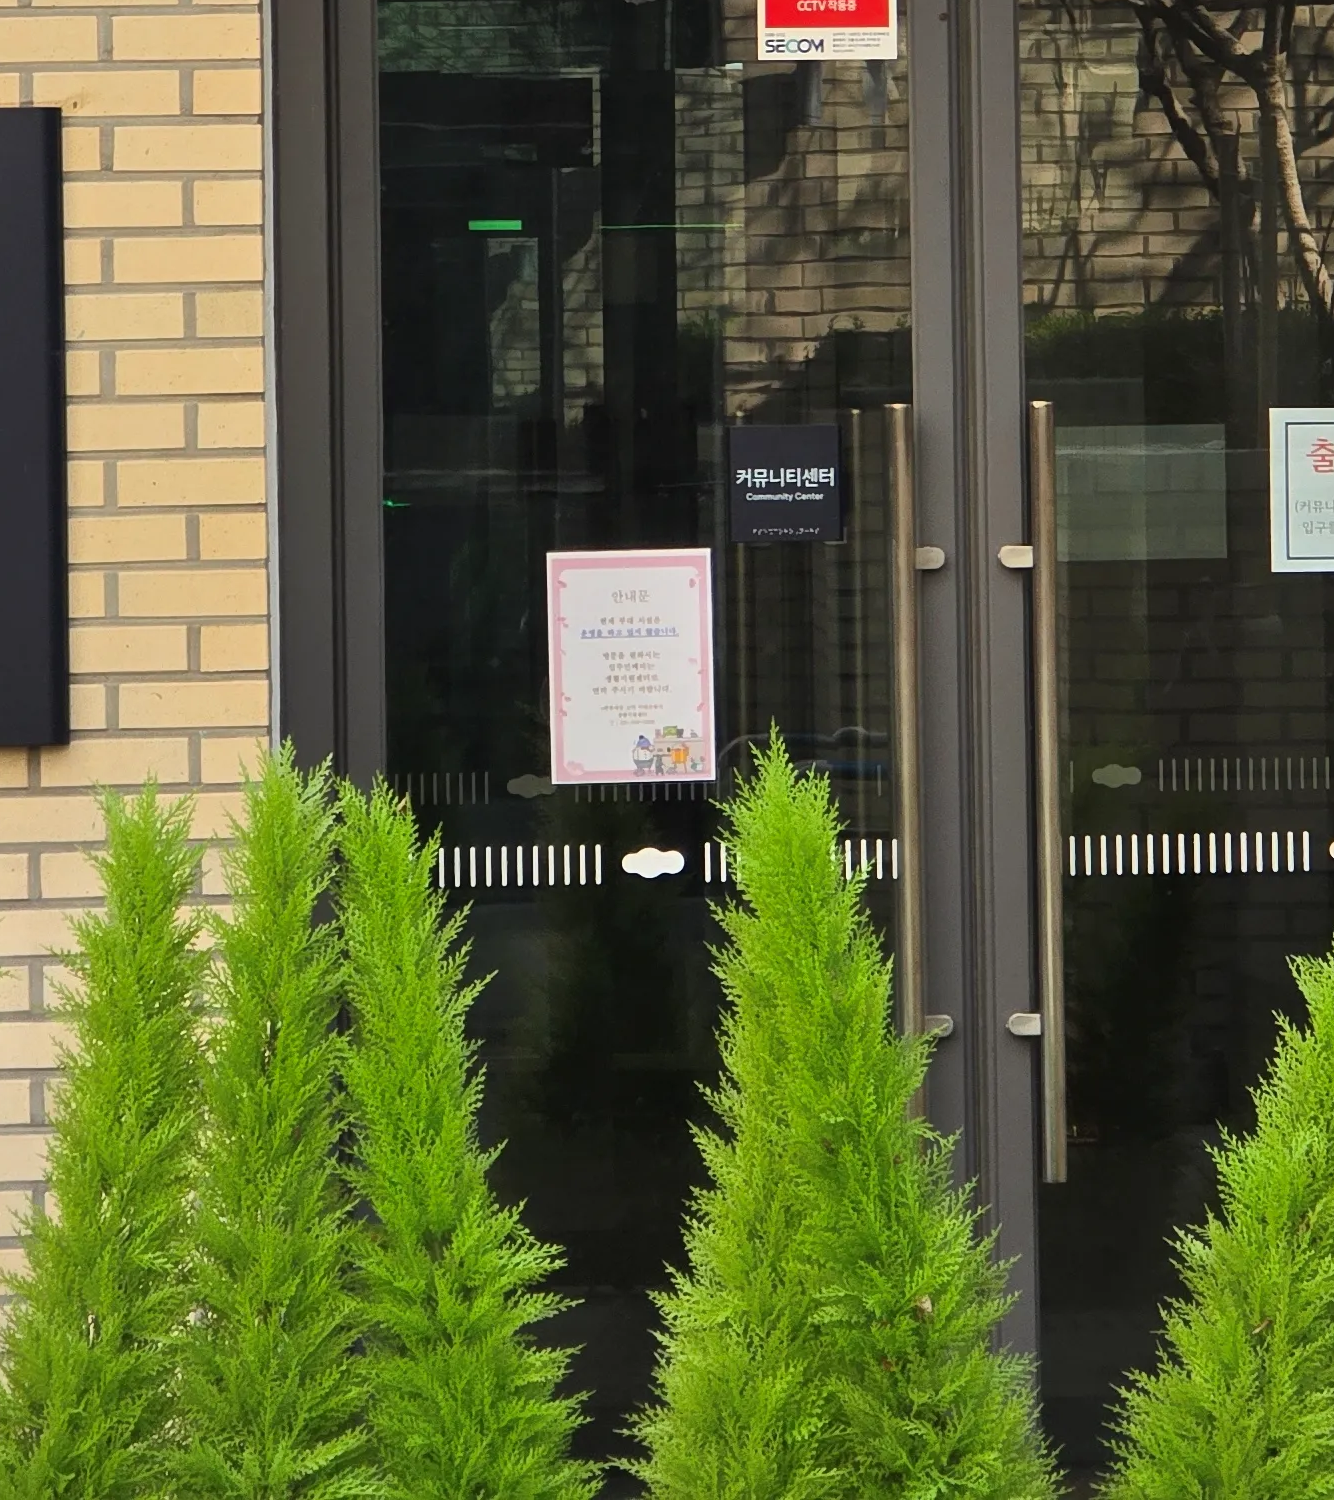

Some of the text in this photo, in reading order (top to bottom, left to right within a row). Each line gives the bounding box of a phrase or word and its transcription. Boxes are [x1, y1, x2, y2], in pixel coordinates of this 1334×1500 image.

[796, 0, 858, 12] CCTV 작동중
[764, 38, 825, 54] SECOM
[735, 467, 835, 489] 커뮤니티센터
[745, 491, 825, 503] Community Center
[611, 589, 650, 604] 안내문
